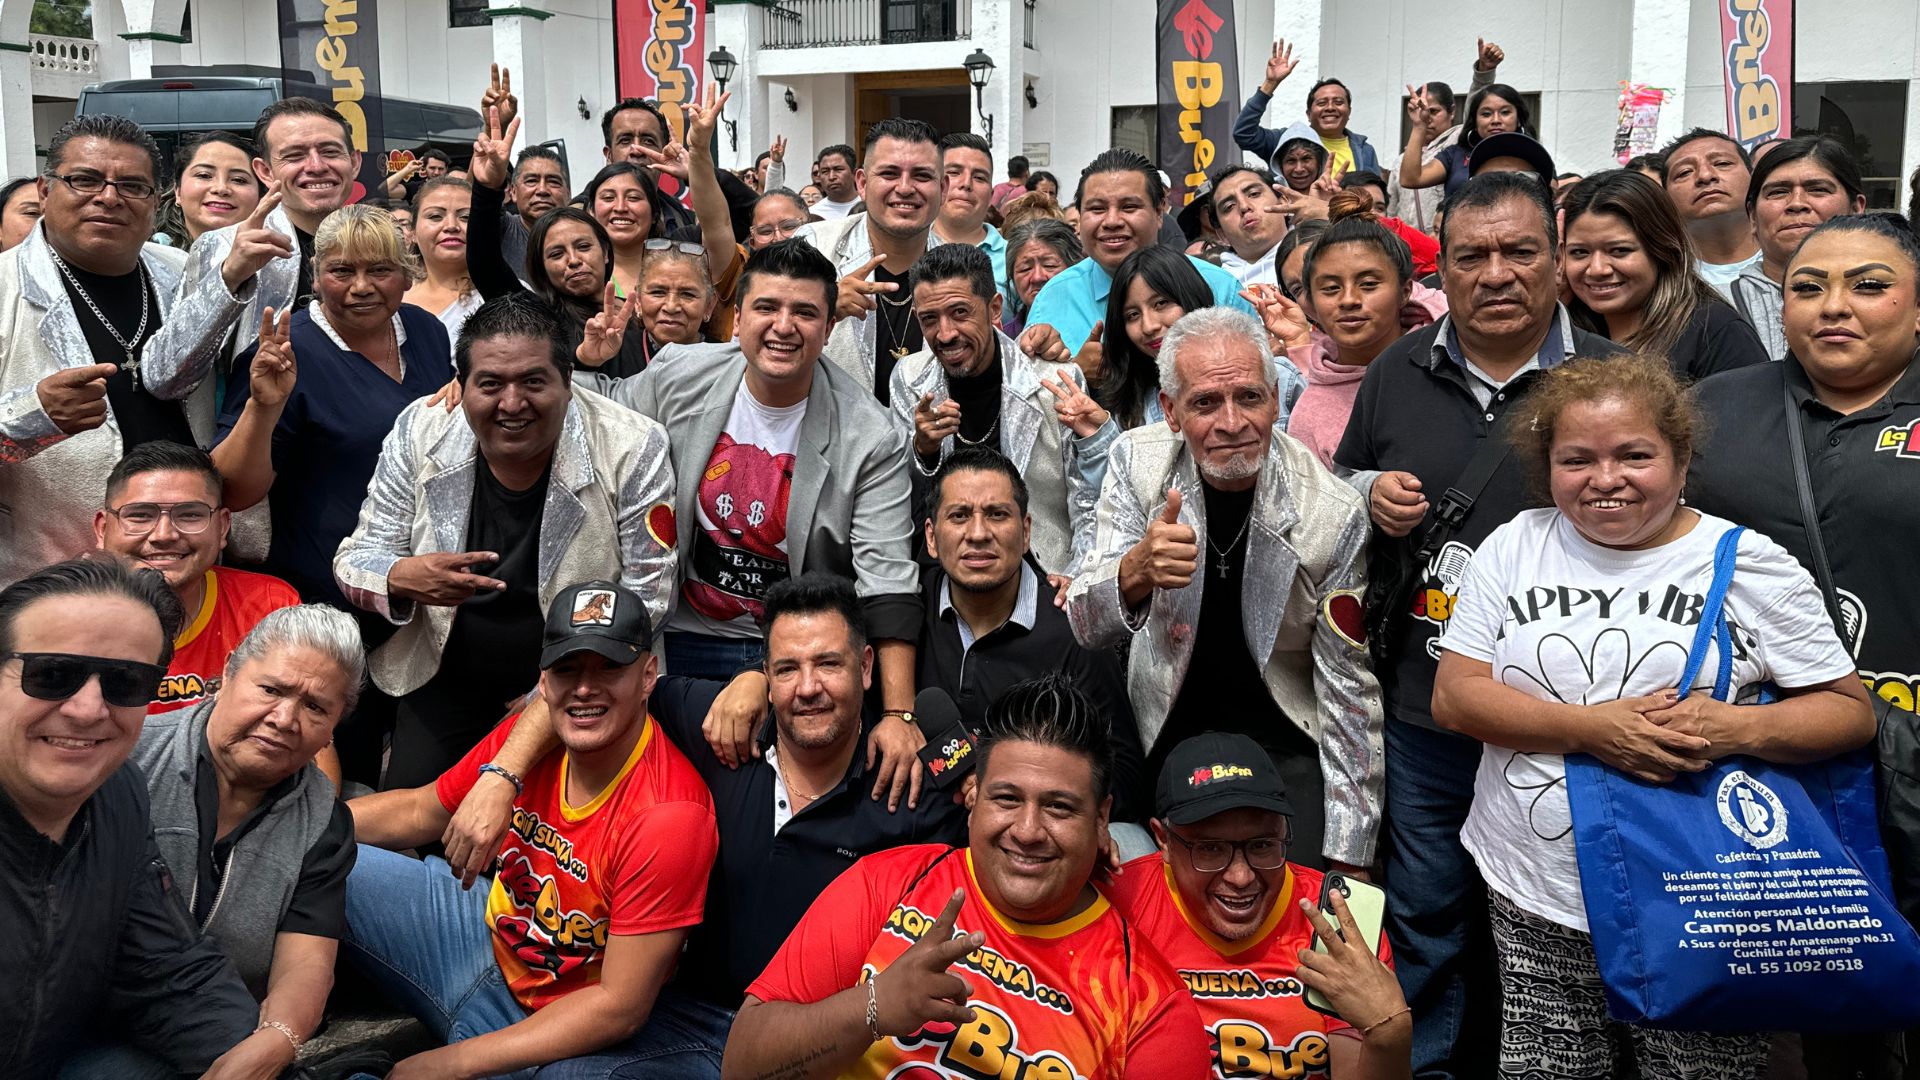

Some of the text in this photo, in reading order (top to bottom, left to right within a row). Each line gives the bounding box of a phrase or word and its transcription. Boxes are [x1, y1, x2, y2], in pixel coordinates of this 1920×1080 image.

[1881, 430, 1907, 447] La
[1497, 584, 1625, 641] APPY
[1718, 783, 1732, 804] Pax
[1731, 773, 1742, 783] et
[836, 847, 858, 858] BOSS
[1763, 853, 1770, 864] y
[1662, 871, 1678, 881] Un
[1680, 870, 1719, 881] cliente
[1733, 870, 1760, 879] como
[1760, 871, 1772, 879] un
[1773, 867, 1802, 878] amigo
[1664, 882, 1720, 892] deseamos
[1721, 881, 1733, 891] el
[1733, 880, 1757, 891] bien
[1758, 882, 1764, 891] y
[1765, 879, 1780, 889] del
[1802, 879, 1818, 888] nos
[1679, 894, 1698, 905] por
[1700, 894, 1713, 902] su
[1714, 891, 1762, 902] felicidad
[1820, 889, 1832, 898] un
[1832, 887, 1853, 898] feliz
[1694, 903, 1869, 920] Atención personal de la familia
[1684, 915, 1883, 936] Campos Maldonado
[1678, 933, 1896, 949] A Sus órdenes en Amatenango No.31
[1733, 945, 1854, 958] Cuchilla de Padierna
[1727, 958, 1864, 975] Tel. 55 1092 0518
